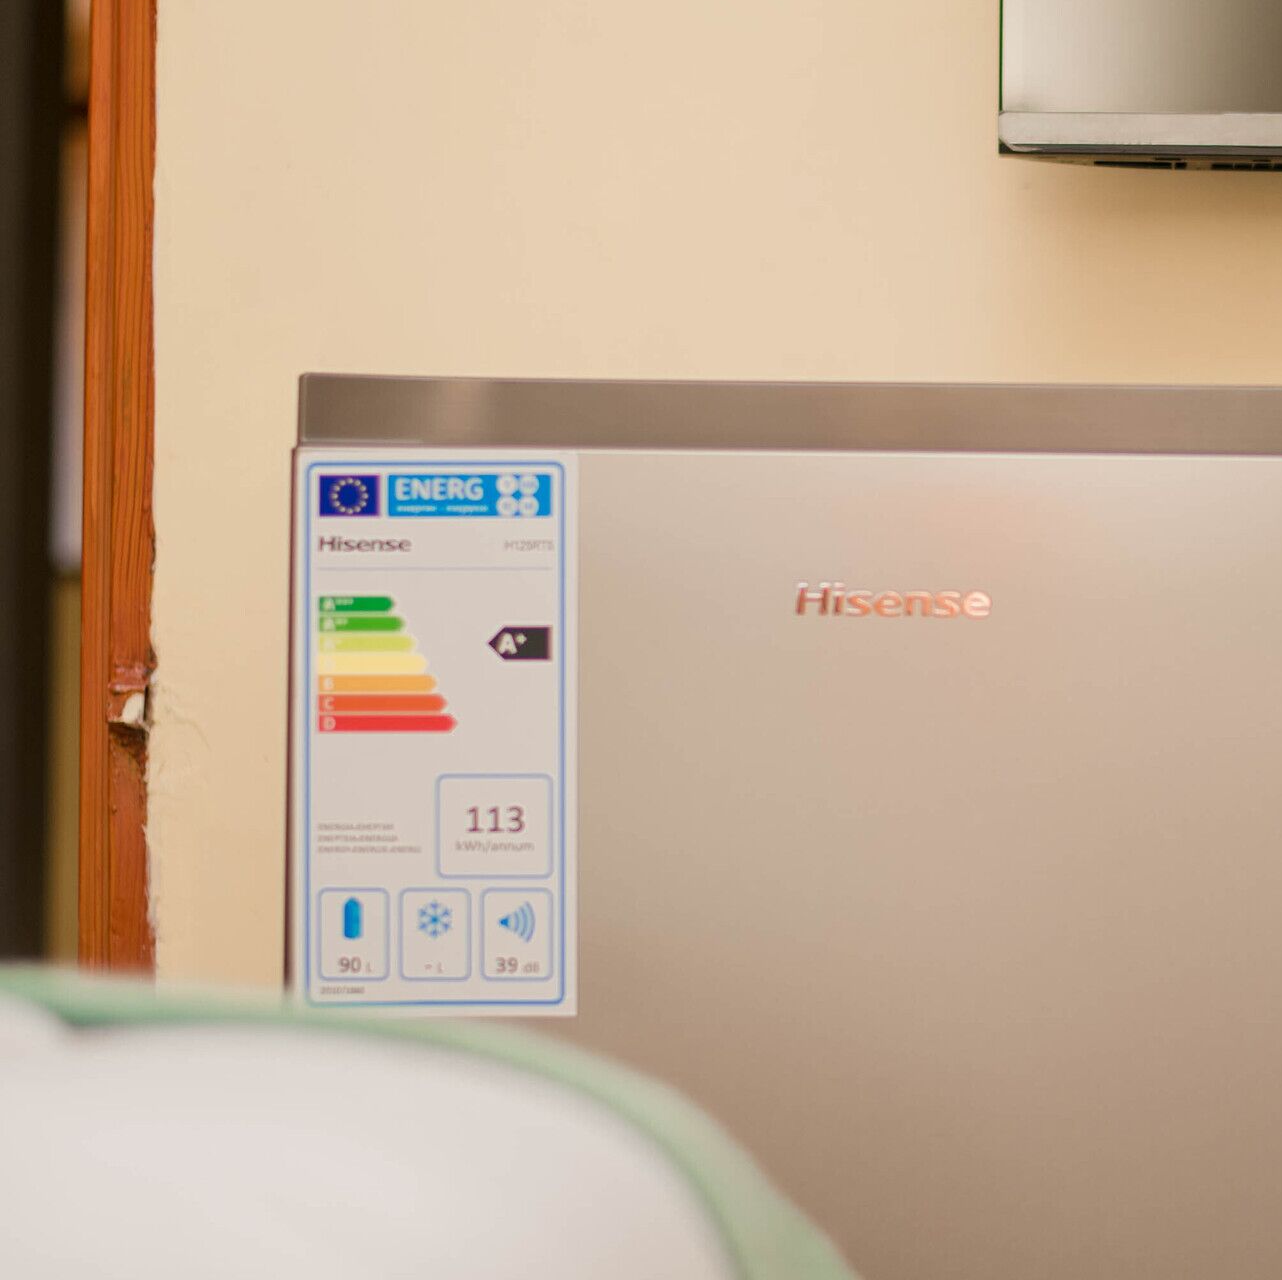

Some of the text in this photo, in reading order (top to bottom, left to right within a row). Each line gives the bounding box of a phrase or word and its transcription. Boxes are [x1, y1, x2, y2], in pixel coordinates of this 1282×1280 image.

[395, 478, 484, 501] ENERG
[317, 536, 412, 553] Hisense
[794, 581, 993, 618] Hisense
[499, 632, 528, 655] A+
[466, 806, 525, 833] 113
[455, 840, 535, 854] kWh/annum
[338, 956, 361, 974] 90
[496, 957, 518, 974] 39
